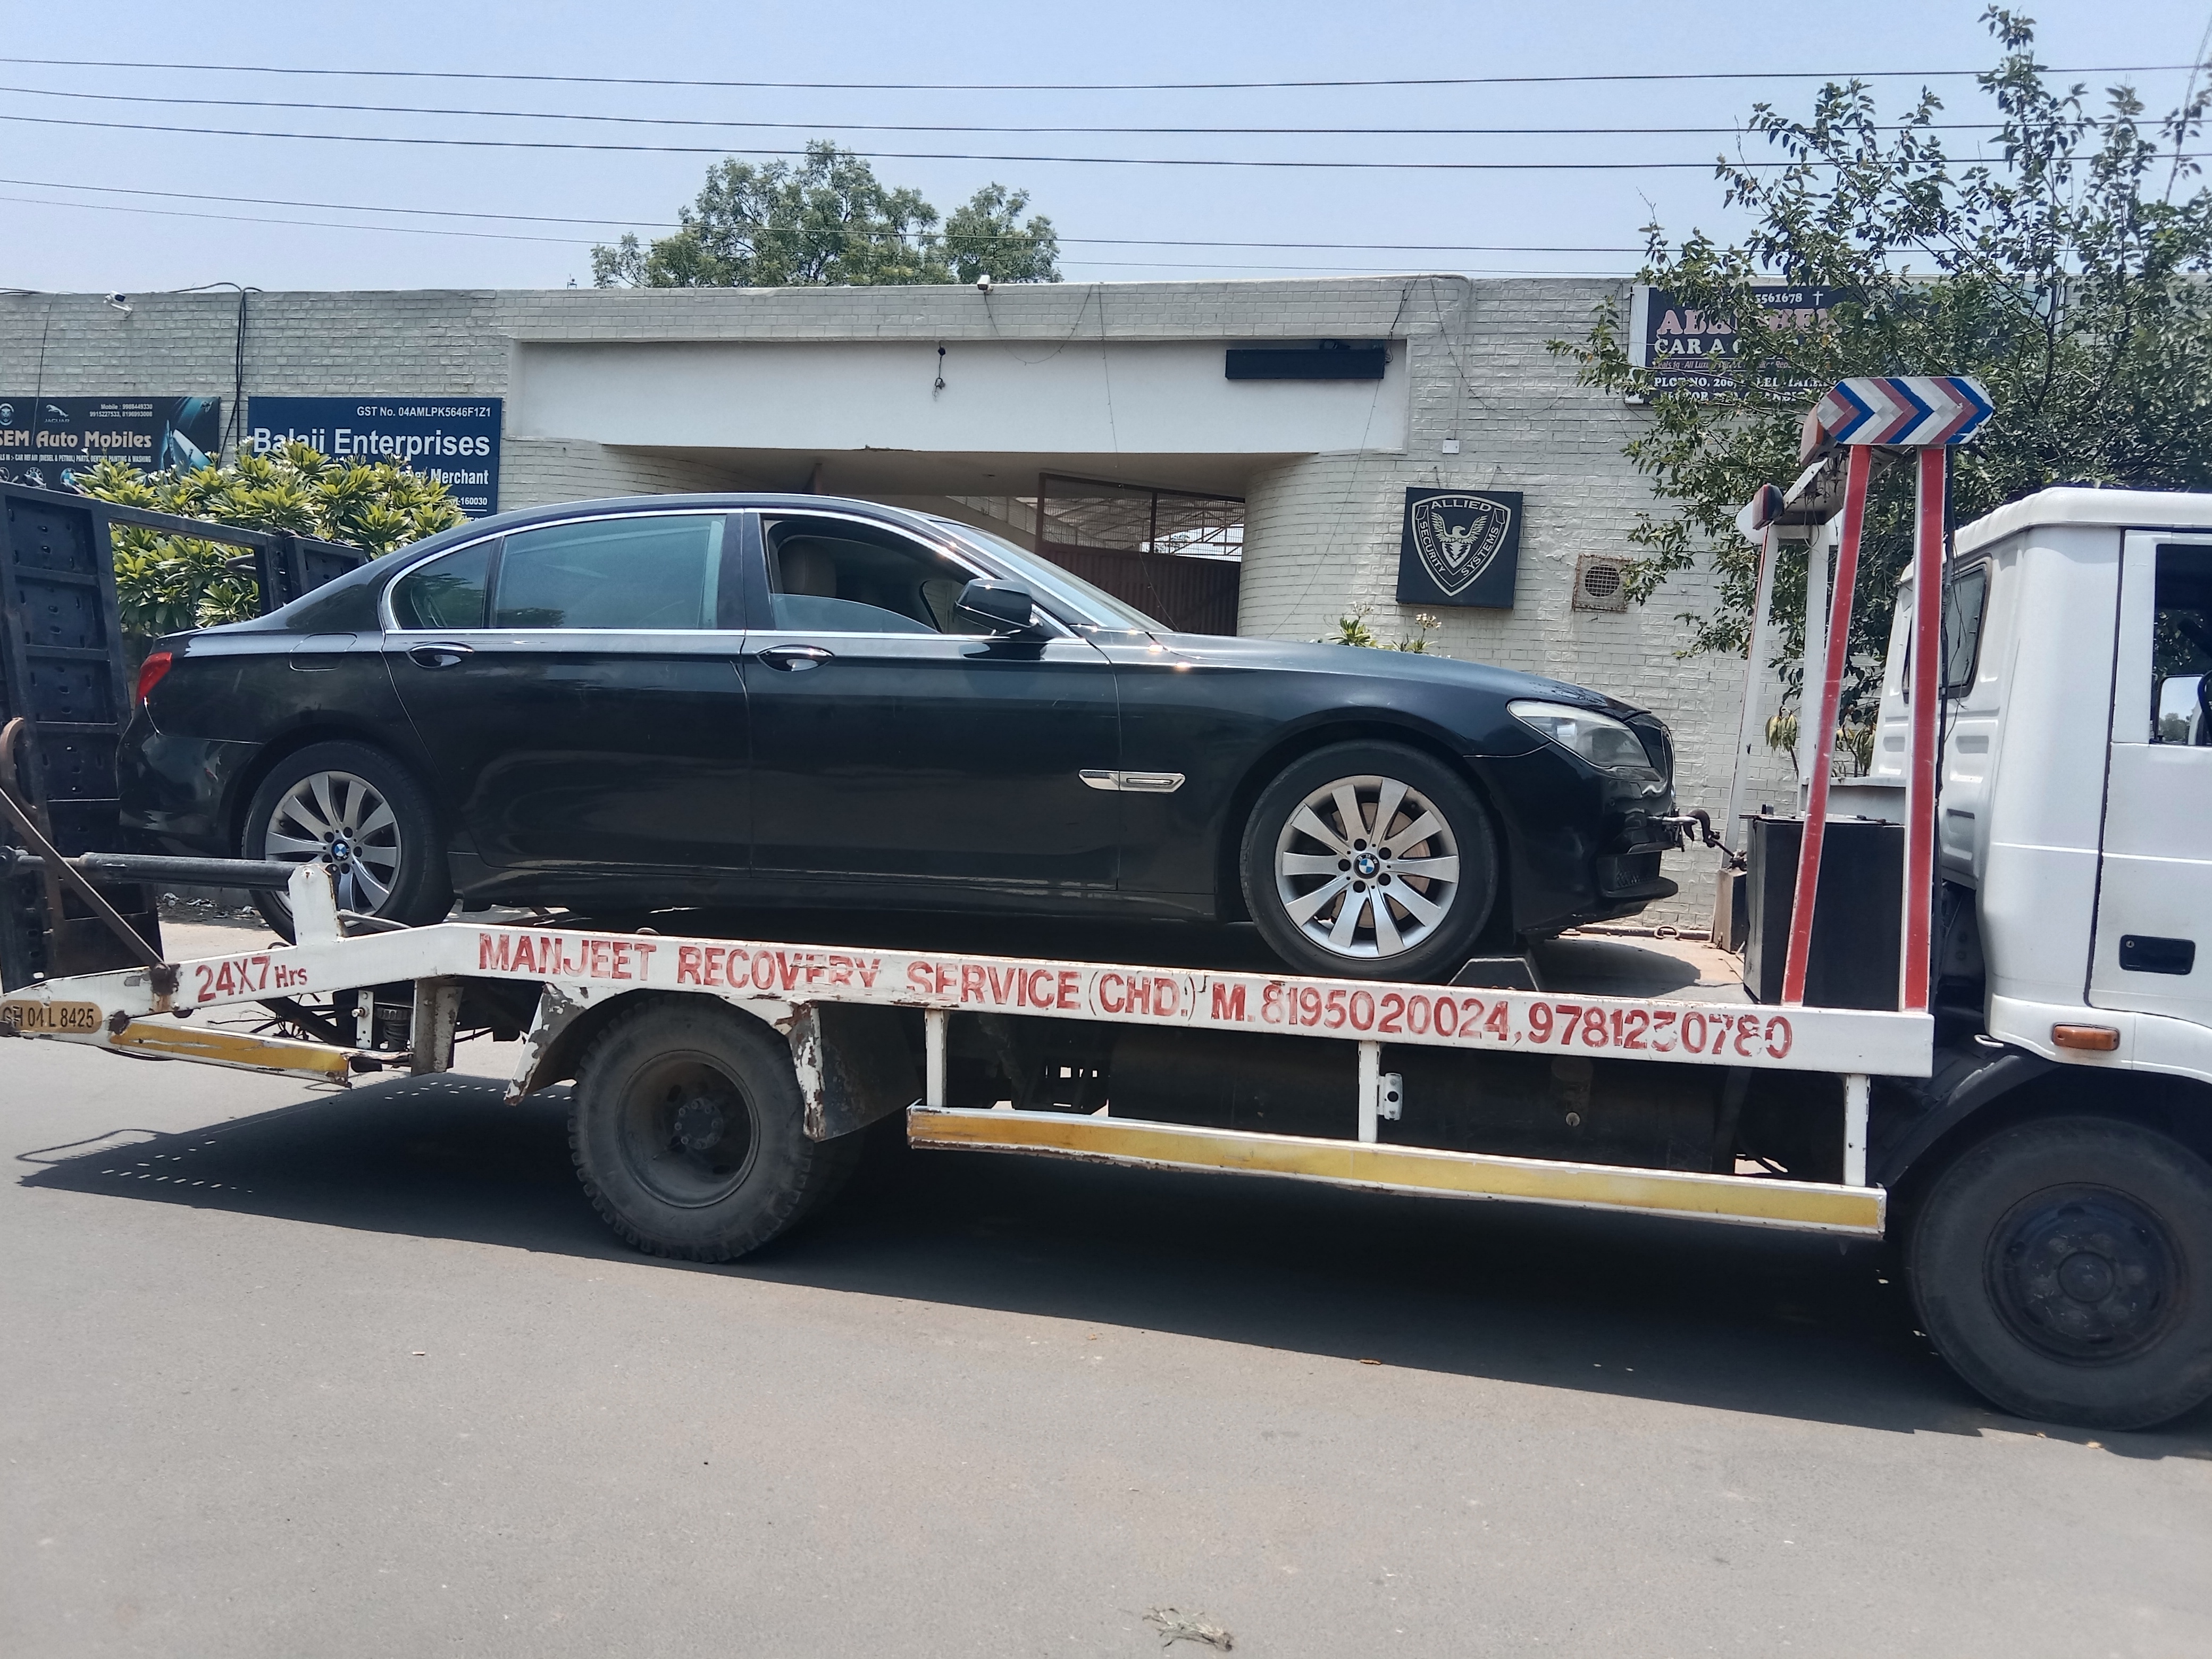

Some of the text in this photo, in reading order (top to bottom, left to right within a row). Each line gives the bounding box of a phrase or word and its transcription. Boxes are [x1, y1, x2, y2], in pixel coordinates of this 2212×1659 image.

[1654, 339, 1703, 355] CAR
[357, 406, 491, 417] GST No. 04AMLPK5646F1Z1
[36, 430, 78, 448] Auto
[85, 431, 152, 448] Mobiles
[334, 428, 490, 461] Enterprises
[431, 468, 489, 485] Merchant
[1431, 499, 1492, 513] ALLIED
[1420, 521, 1499, 576] SECURITY SYSTEMS
[195, 956, 307, 1003] 24X7 Hrs
[479, 932, 657, 981] MANJEET
[677, 945, 882, 991] RECOVERY
[906, 960, 1083, 1010] SERVICE
[61, 1008, 94, 1028] 8425
